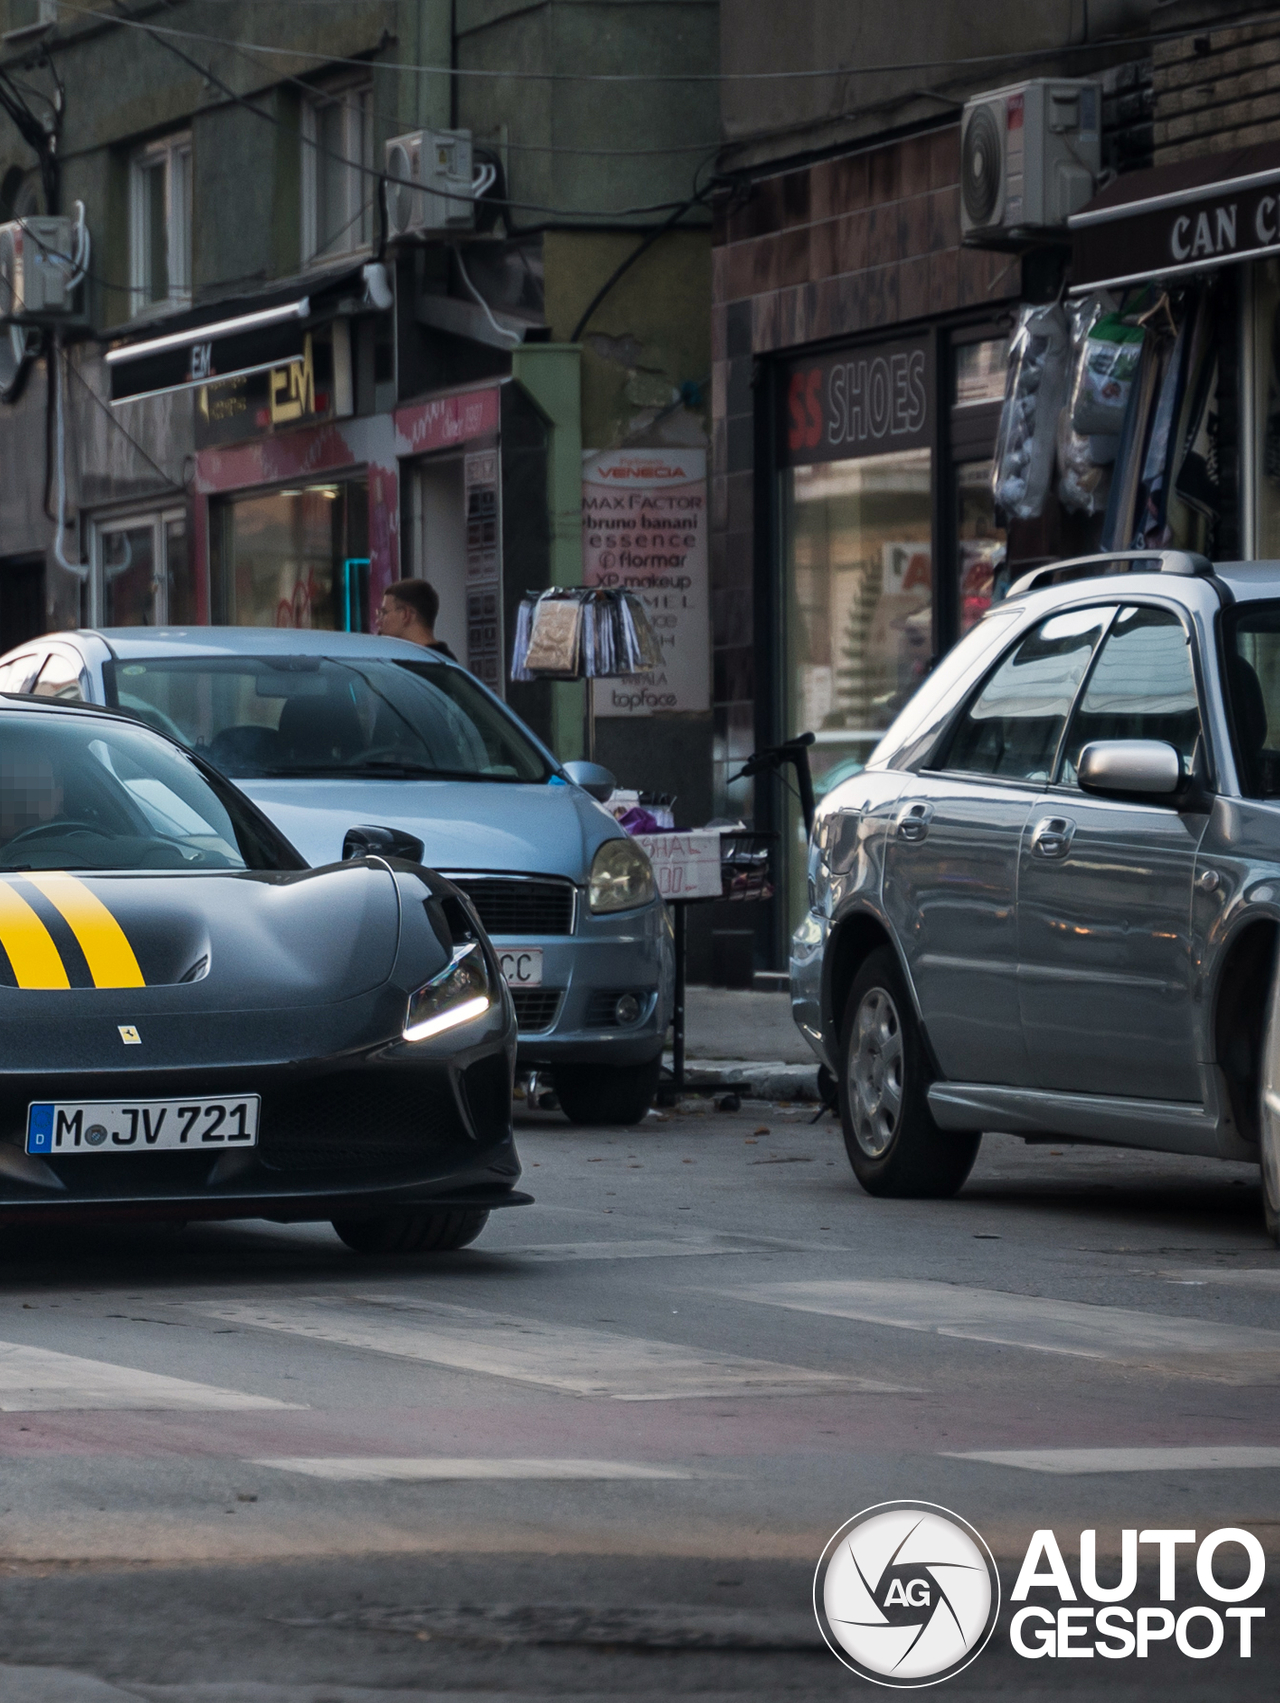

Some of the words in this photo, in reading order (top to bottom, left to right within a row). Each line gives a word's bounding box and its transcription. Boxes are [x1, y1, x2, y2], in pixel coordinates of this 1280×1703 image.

[1171, 204, 1237, 260] CAN
[1256, 195, 1280, 246] C
[271, 332, 316, 425] EM
[828, 350, 927, 446] SHOES
[598, 466, 687, 479] VENECIA
[581, 496, 625, 511] MAX
[628, 493, 702, 511] FACTOR
[586, 514, 637, 530] bruno
[641, 513, 698, 530] banani
[589, 533, 696, 549] essence
[619, 550, 686, 568] flormar
[596, 572, 620, 588] XP
[624, 573, 692, 591] makeup
[612, 687, 678, 712] topface
[55, 1109, 84, 1147] M
[112, 1108, 168, 1145] JV
[177, 1103, 252, 1143] 721
[35, 1133, 45, 1146] D
